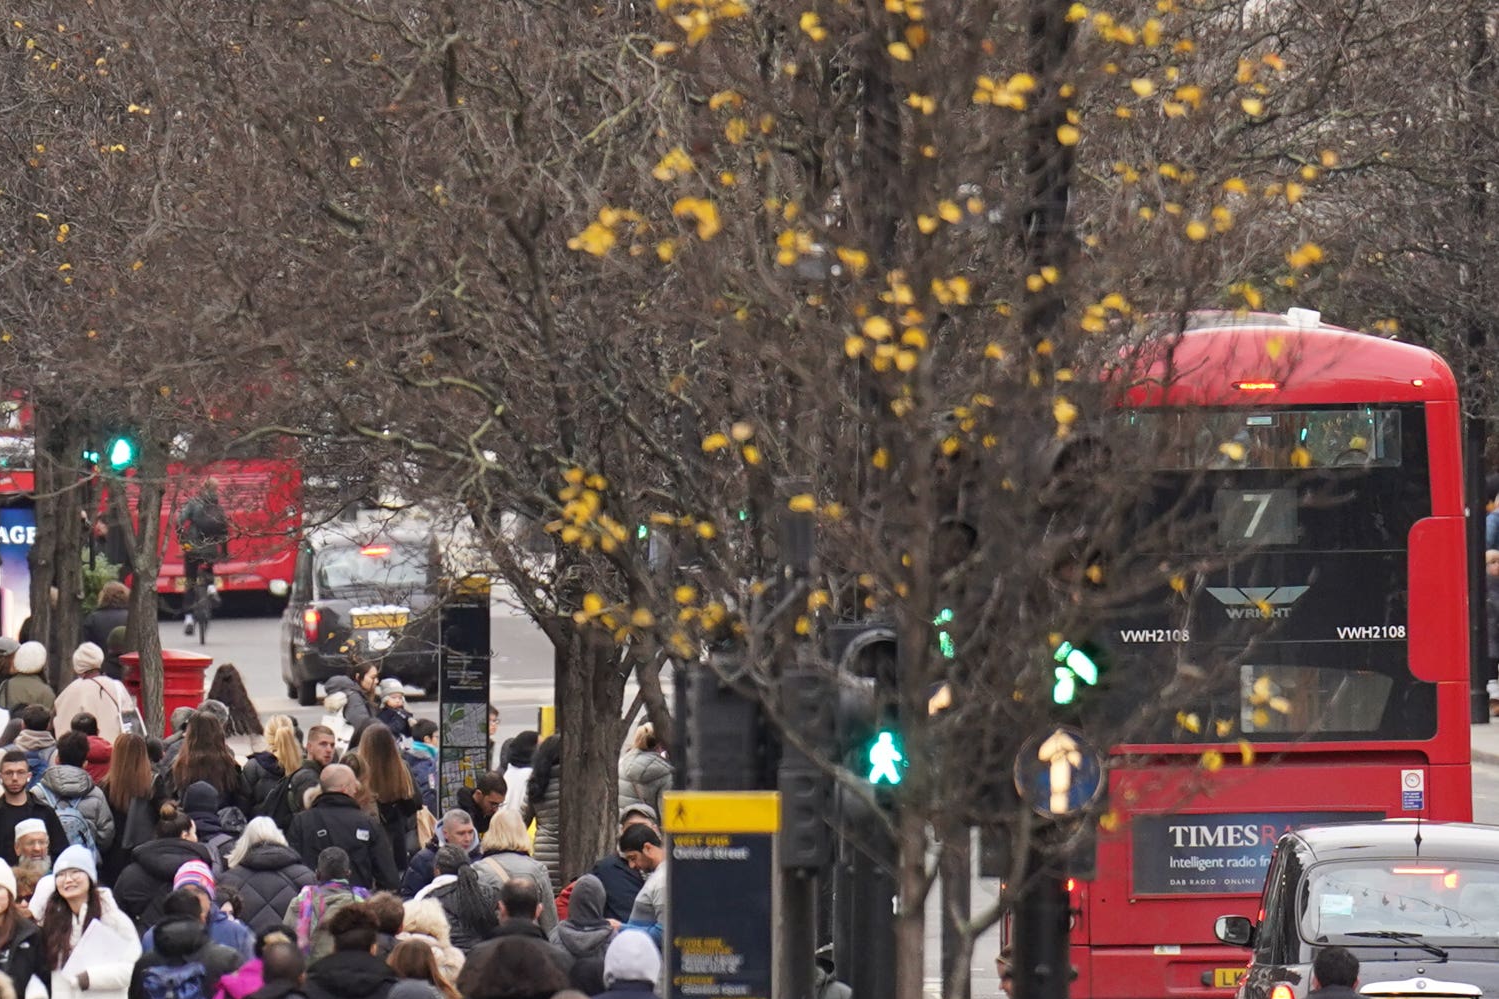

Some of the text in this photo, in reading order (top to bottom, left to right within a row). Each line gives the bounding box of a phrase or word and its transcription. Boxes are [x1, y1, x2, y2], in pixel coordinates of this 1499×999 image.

[1242, 494, 1272, 538] 7
[1120, 630, 1191, 643] VWH2108
[1336, 626, 1406, 640] VWH2108
[1169, 825, 1259, 848] TIMES
[1170, 856, 1224, 872] Intelligent
[1226, 855, 1257, 868] radio
